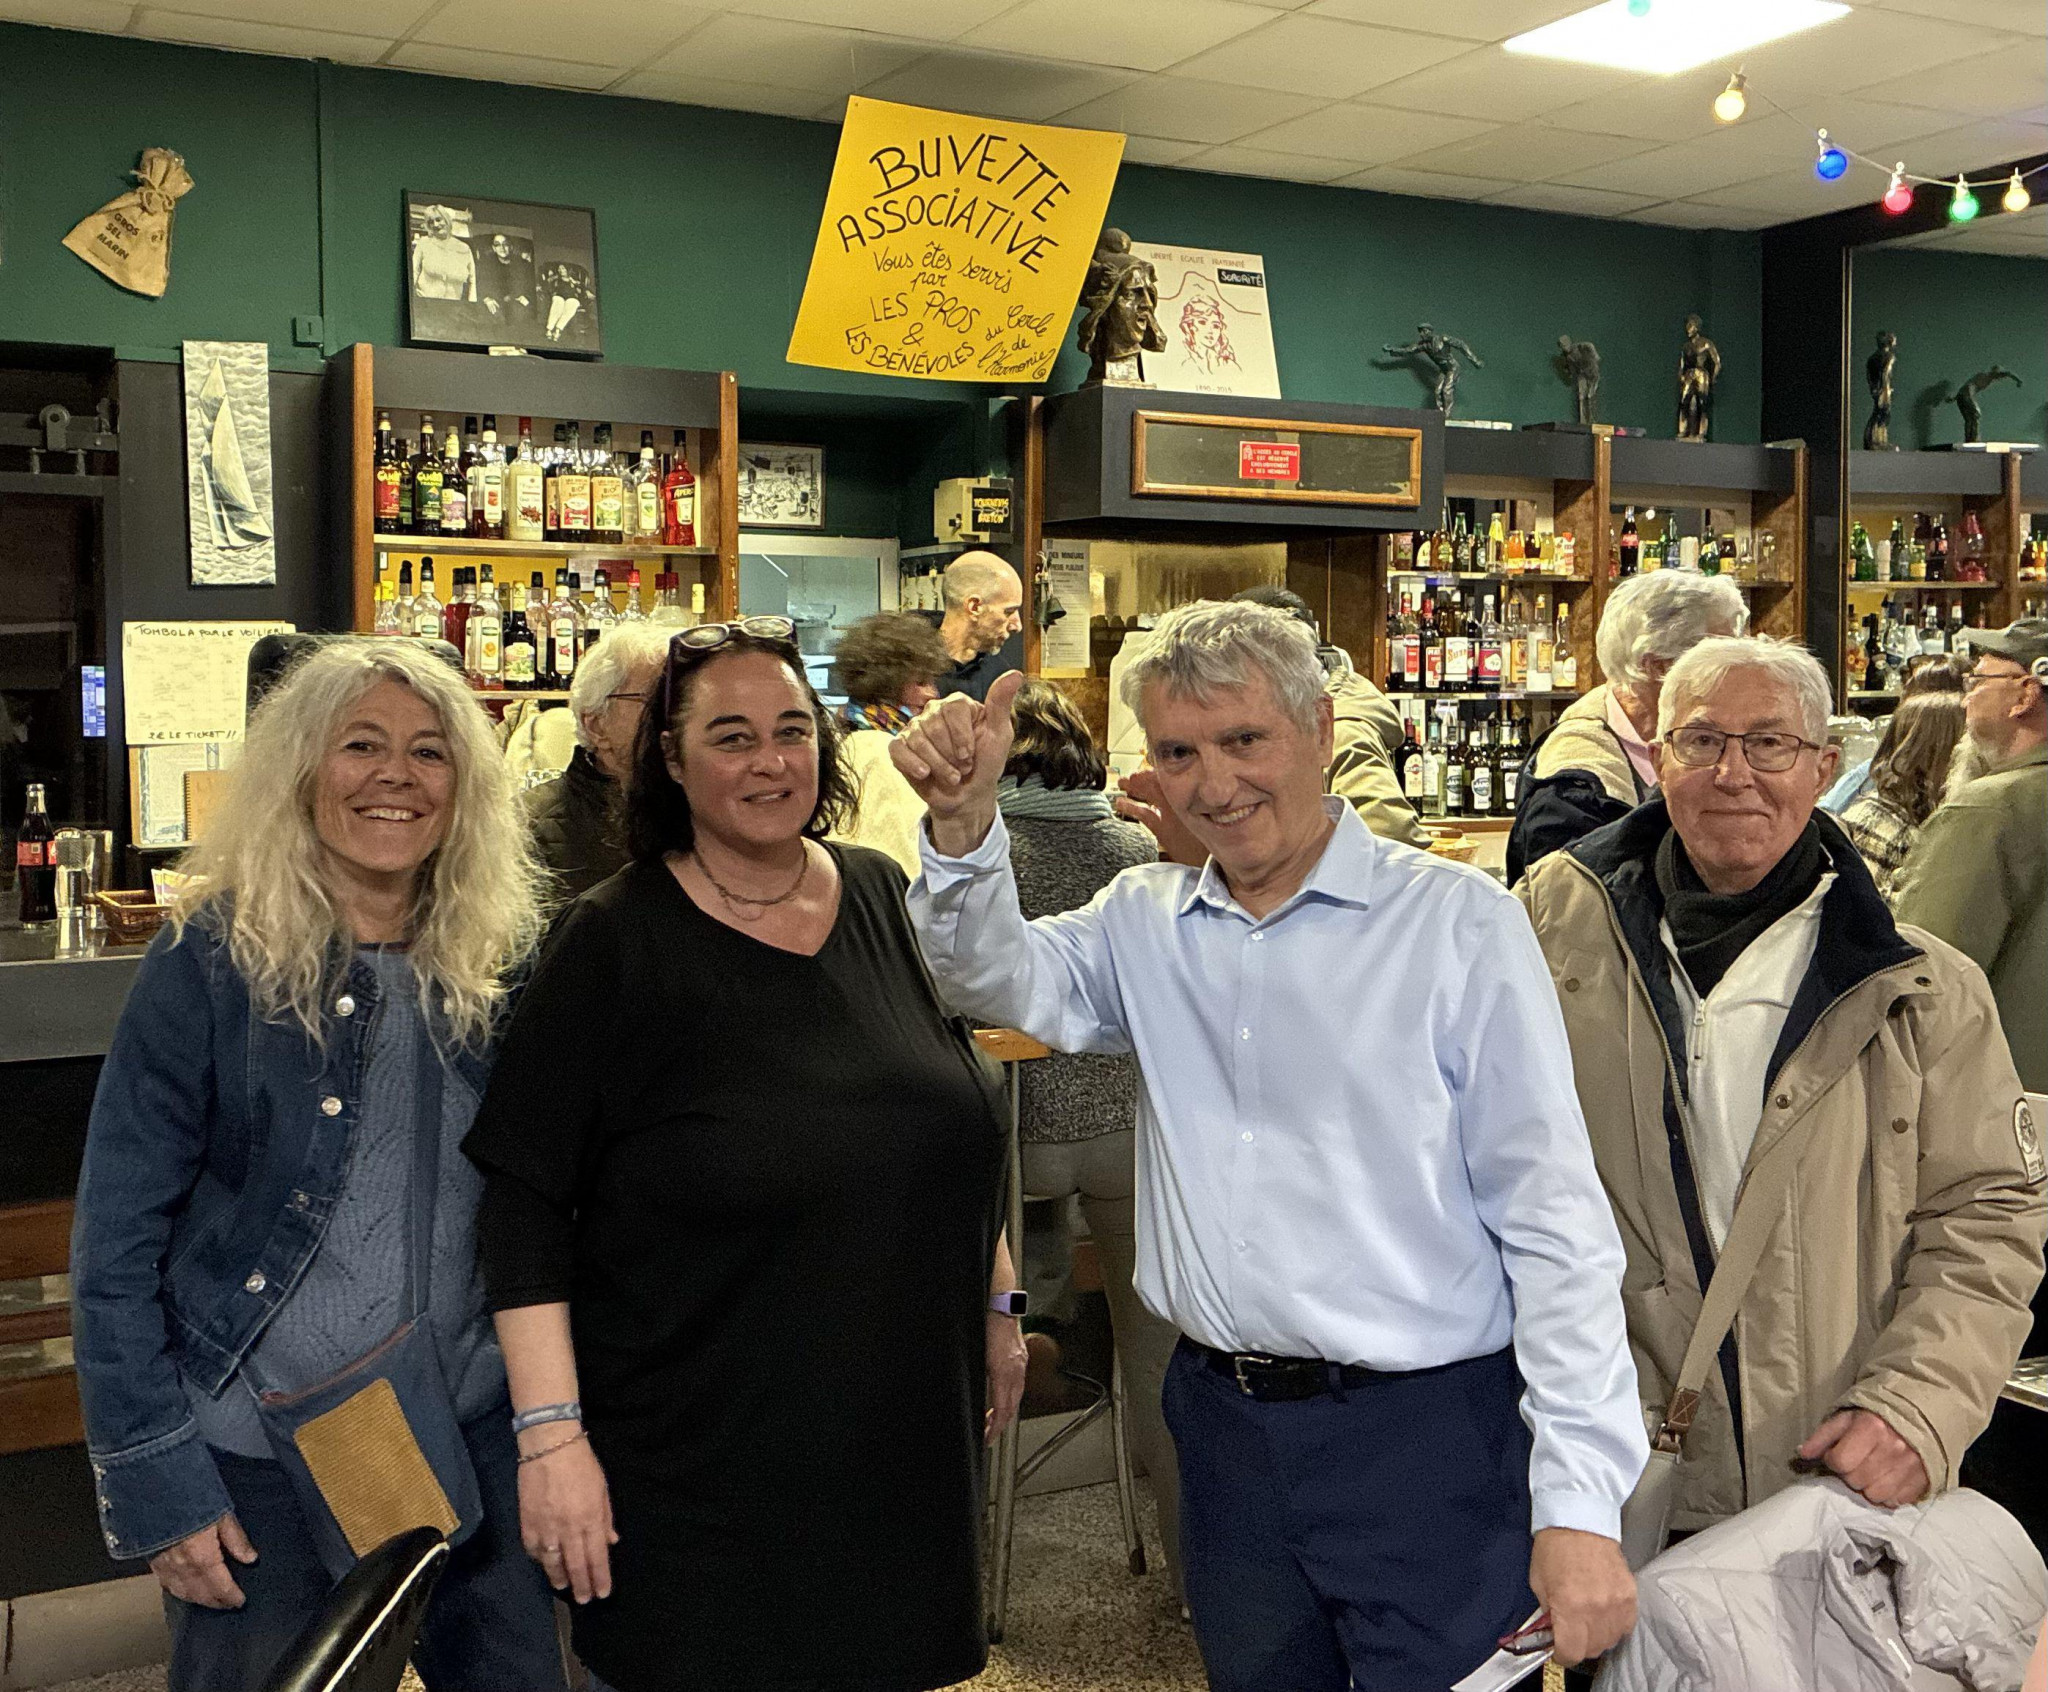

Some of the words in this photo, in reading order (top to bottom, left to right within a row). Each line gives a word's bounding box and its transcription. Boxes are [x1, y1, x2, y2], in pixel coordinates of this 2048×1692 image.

[869, 133, 1070, 222] BUVETTE
[105, 222, 122, 239] SEL
[114, 213, 140, 236] GROS
[97, 233, 130, 260] MARIN
[873, 246, 914, 272] Vous
[922, 240, 952, 271] êtes
[957, 255, 1013, 294] servis
[910, 271, 948, 292] par
[870, 292, 908, 322] LES
[922, 290, 981, 334] PROS
[985, 325, 1004, 341] du
[1007, 305, 1055, 337] Cercle
[901, 322, 925, 347] &
[1012, 333, 1031, 351] de
[865, 341, 976, 375] BÉNÉVOLES
[134, 624, 195, 636] TOMBOLA
[186, 730, 225, 738] TICKET
